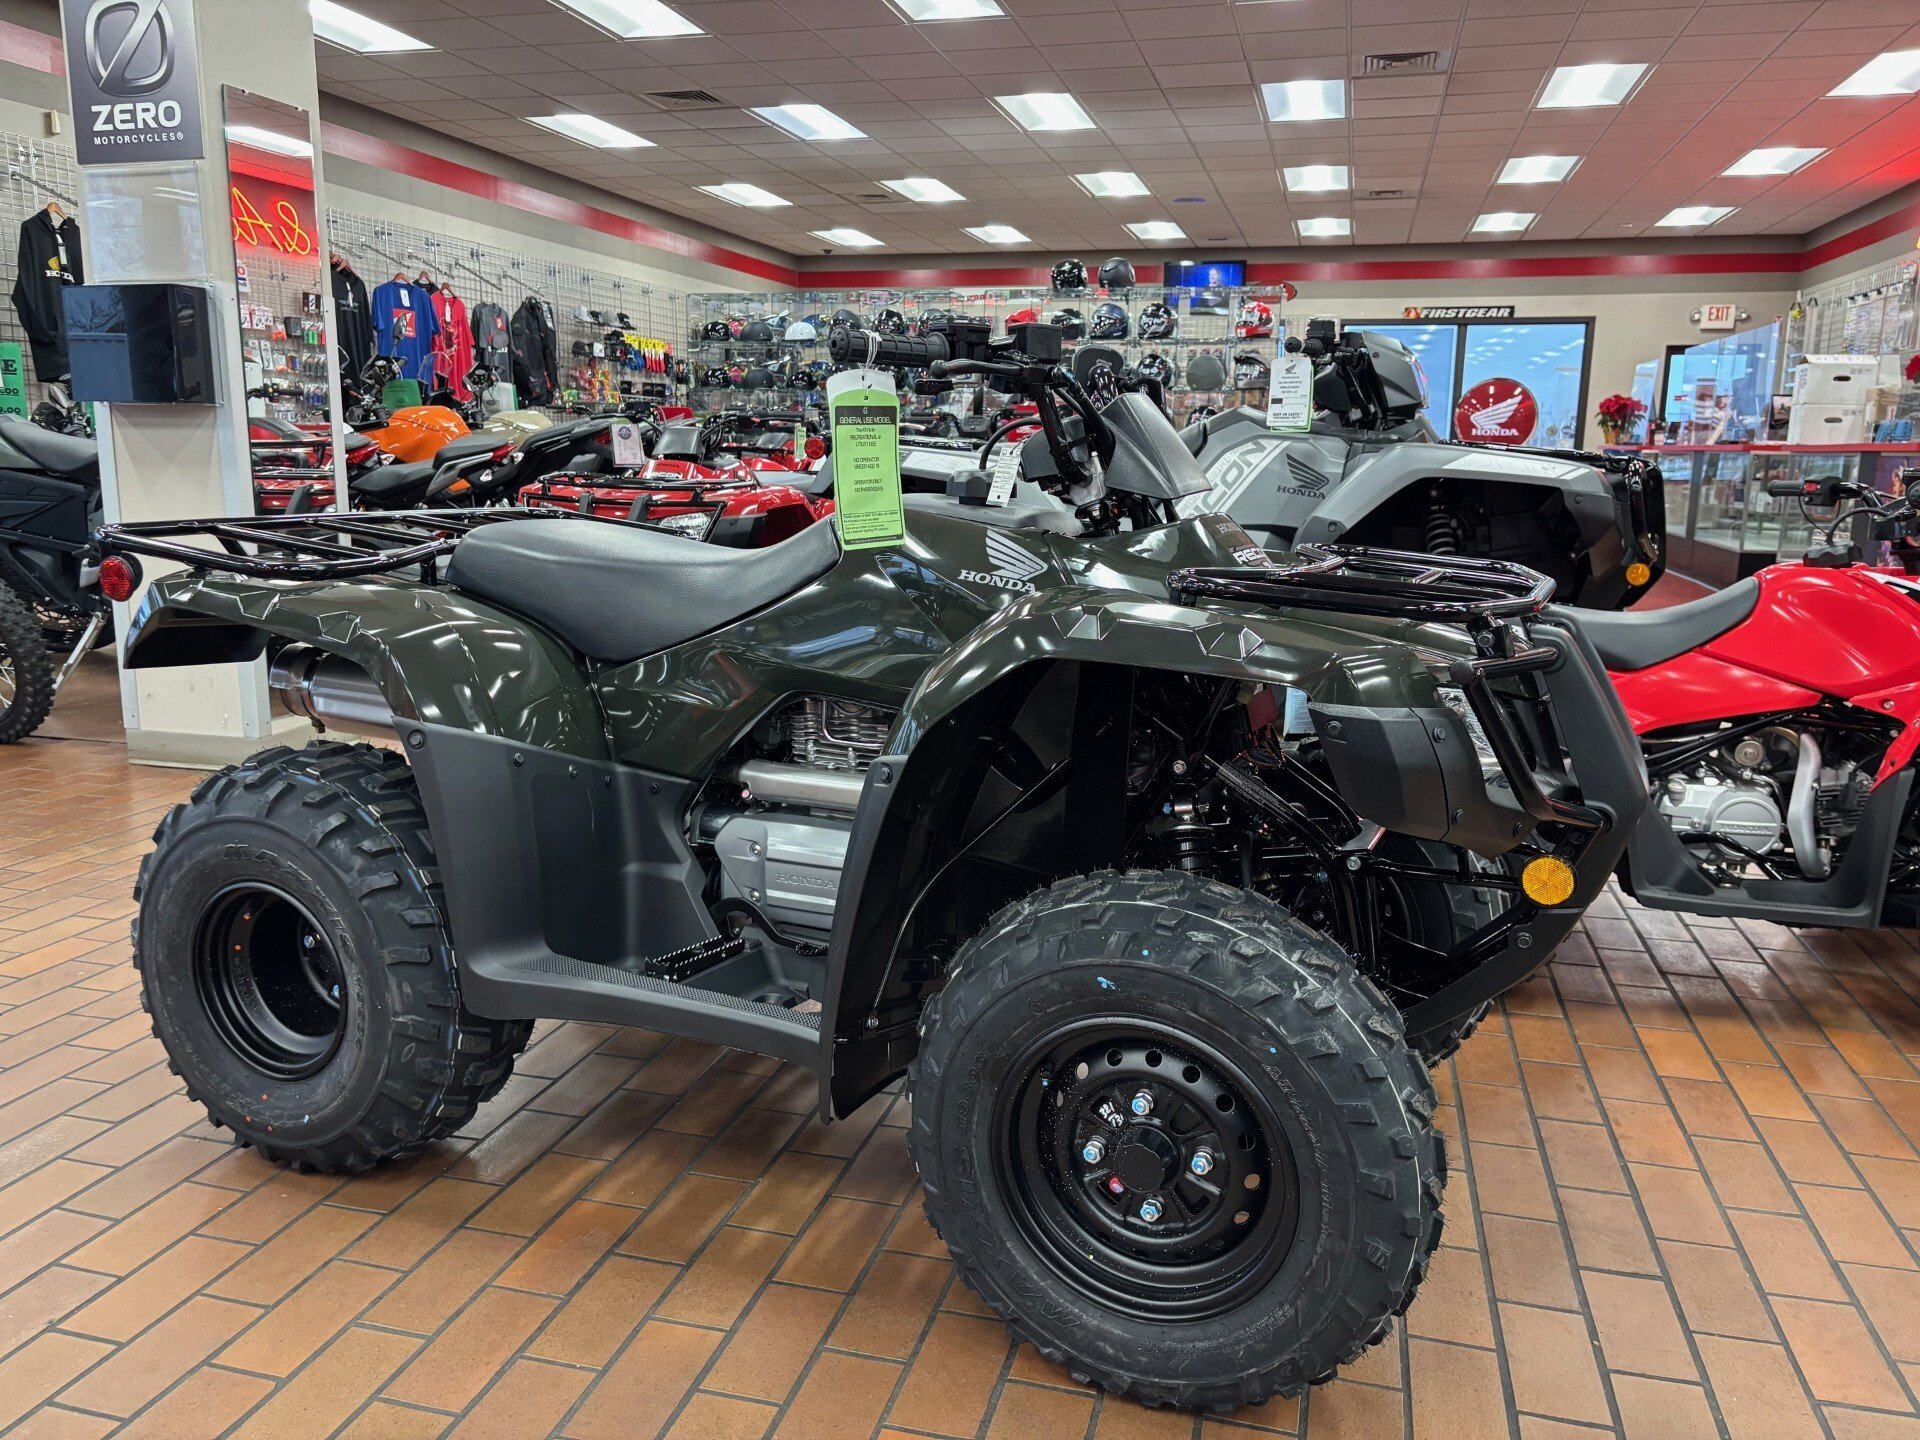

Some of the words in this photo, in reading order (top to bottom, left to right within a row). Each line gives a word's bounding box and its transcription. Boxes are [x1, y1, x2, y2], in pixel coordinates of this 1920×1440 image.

[91, 100, 181, 131] ZERO
[1420, 307, 1511, 318] FIRSTGEAR
[1708, 306, 1731, 321] EXIT
[863, 416, 873, 424] USE
[874, 416, 892, 424] MODEL
[1471, 428, 1519, 436] HONDA
[1276, 485, 1326, 499] HONDA
[958, 570, 1037, 596] HONDA
[1720, 824, 1773, 834] HONDA
[776, 873, 837, 889] HONDA
[952, 1145, 1081, 1329] MAXXIS
